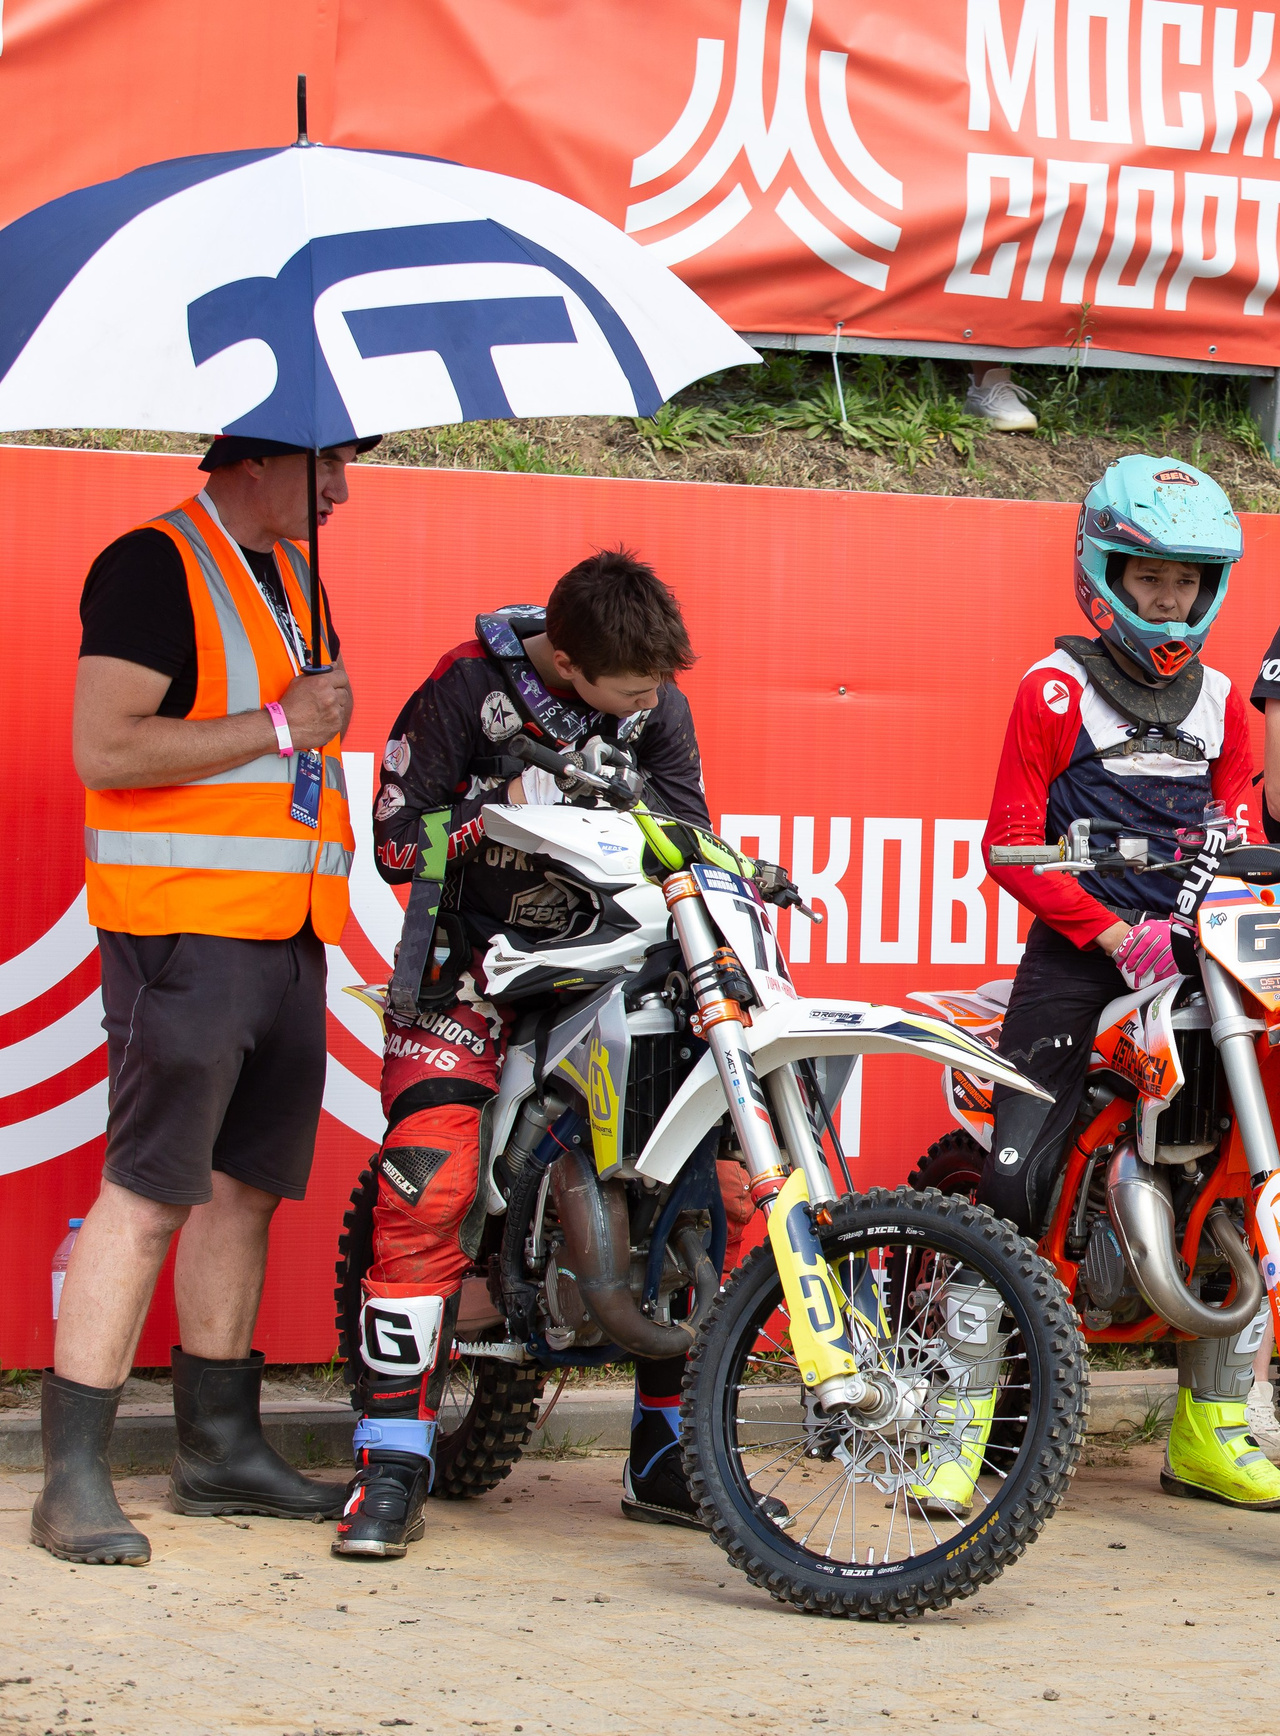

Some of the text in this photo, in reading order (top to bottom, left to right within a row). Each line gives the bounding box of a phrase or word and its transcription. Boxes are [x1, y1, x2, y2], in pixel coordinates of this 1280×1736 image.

[1159, 471, 1194, 485] BELL
[867, 1225, 901, 1236] EXCEL
[945, 1510, 1001, 1562] MAXXIS
